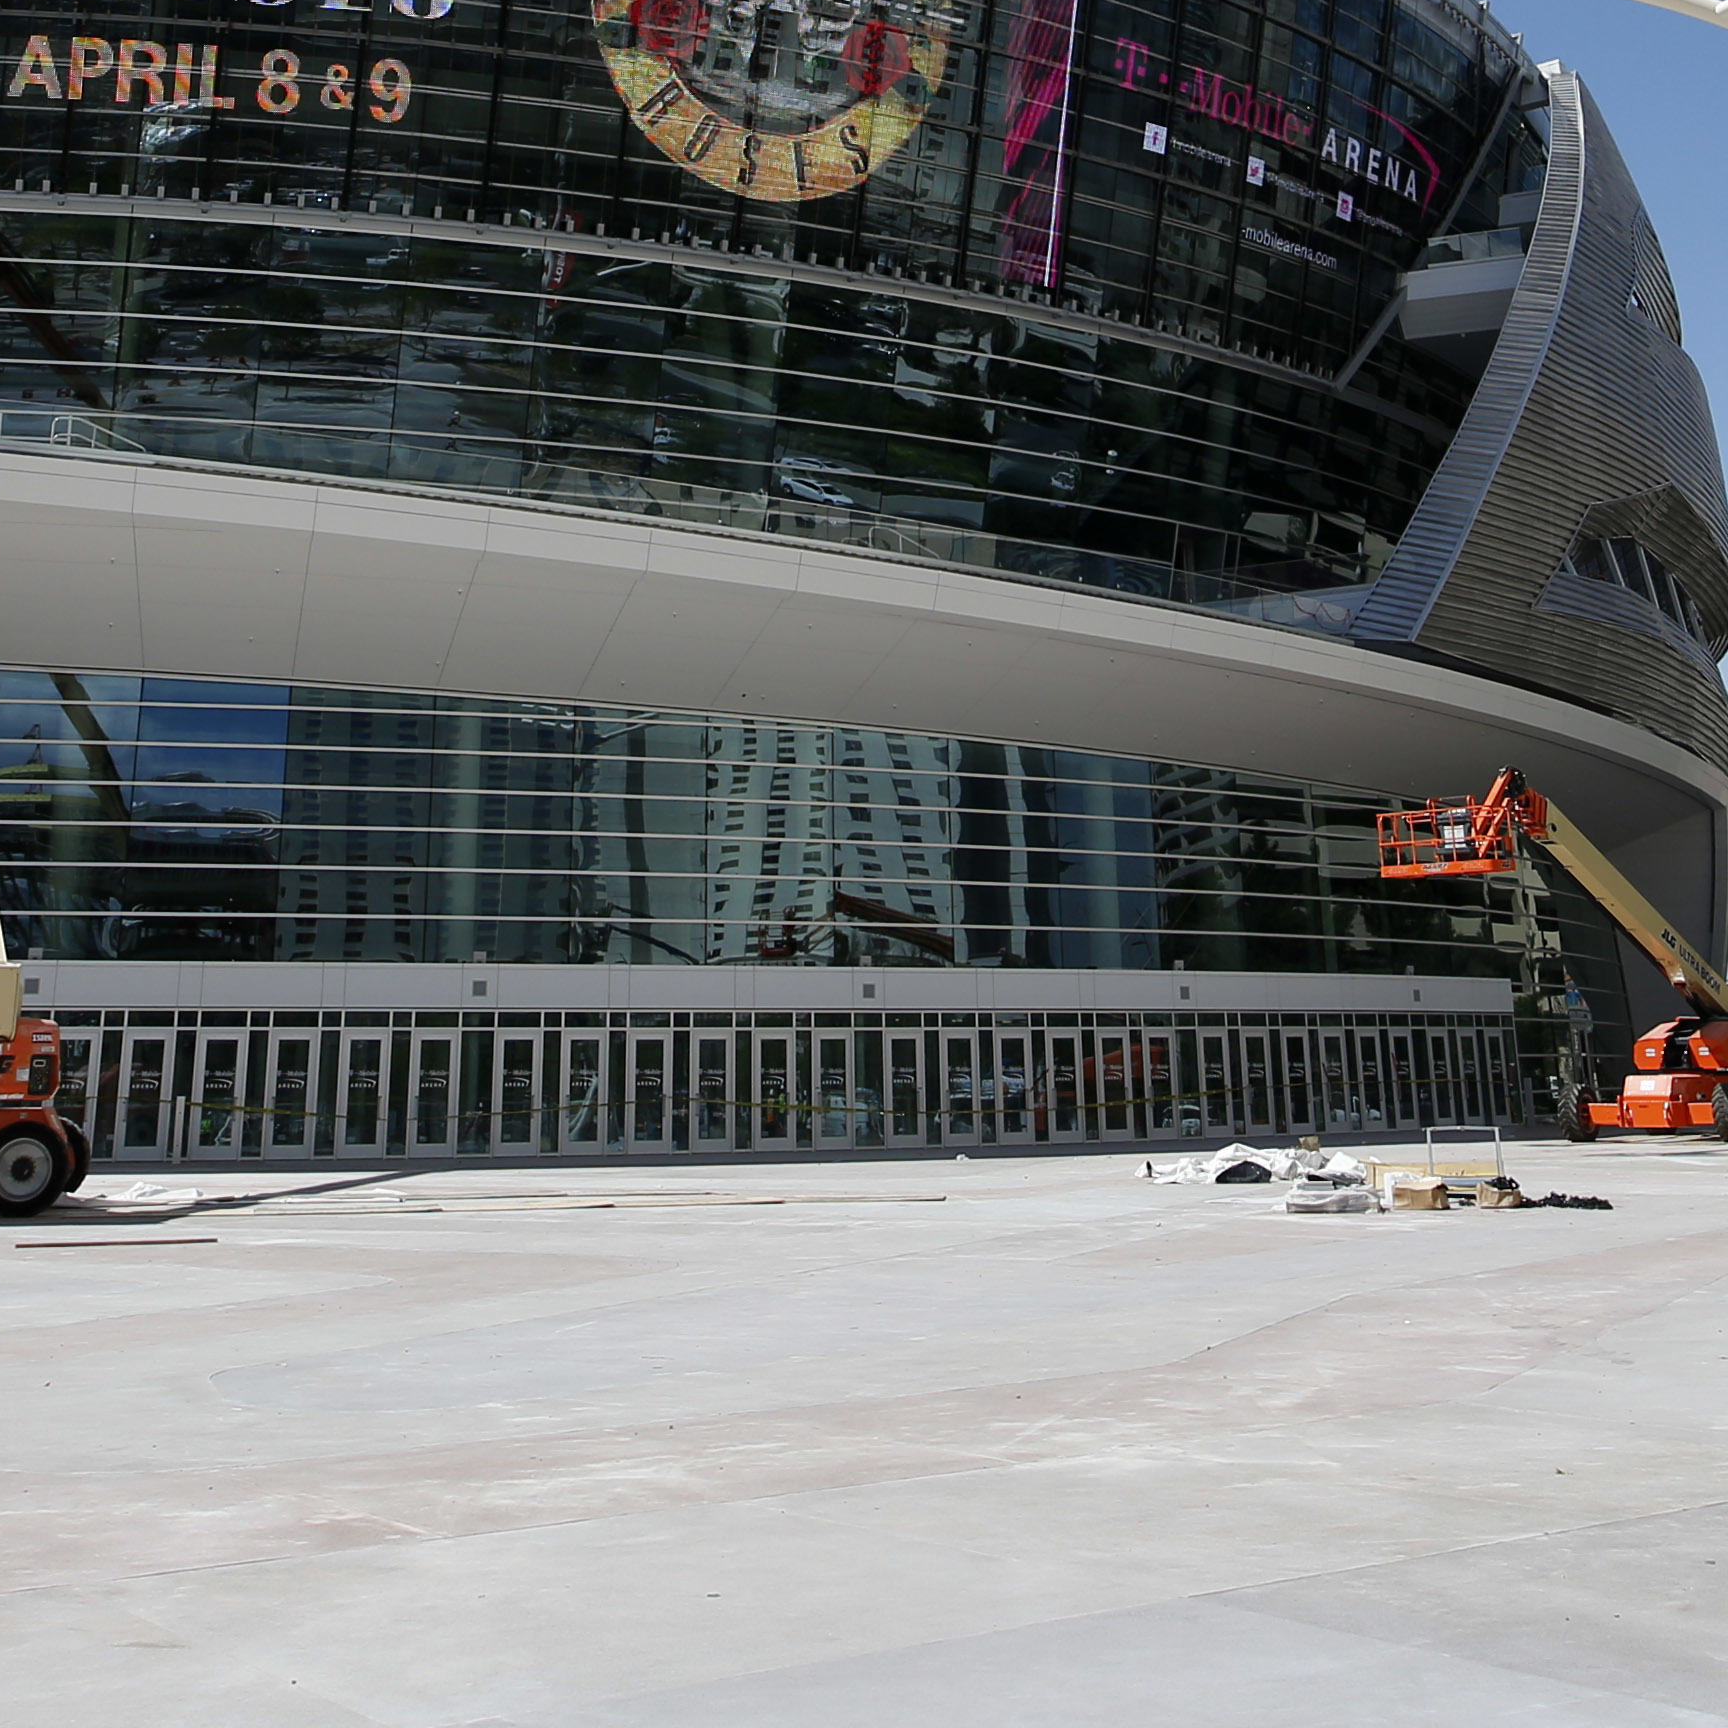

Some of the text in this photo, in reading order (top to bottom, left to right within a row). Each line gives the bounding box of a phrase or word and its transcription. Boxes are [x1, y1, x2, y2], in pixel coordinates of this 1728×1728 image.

[7, 34, 236, 110] APRIL
[255, 48, 301, 115] 8
[320, 62, 355, 111] &
[368, 57, 413, 124] 9
[634, 80, 871, 192] ROSES
[1321, 127, 1418, 203] ARENA
[1678, 944, 1701, 973] ULTRA
[1699, 967, 1721, 995] BOOM
